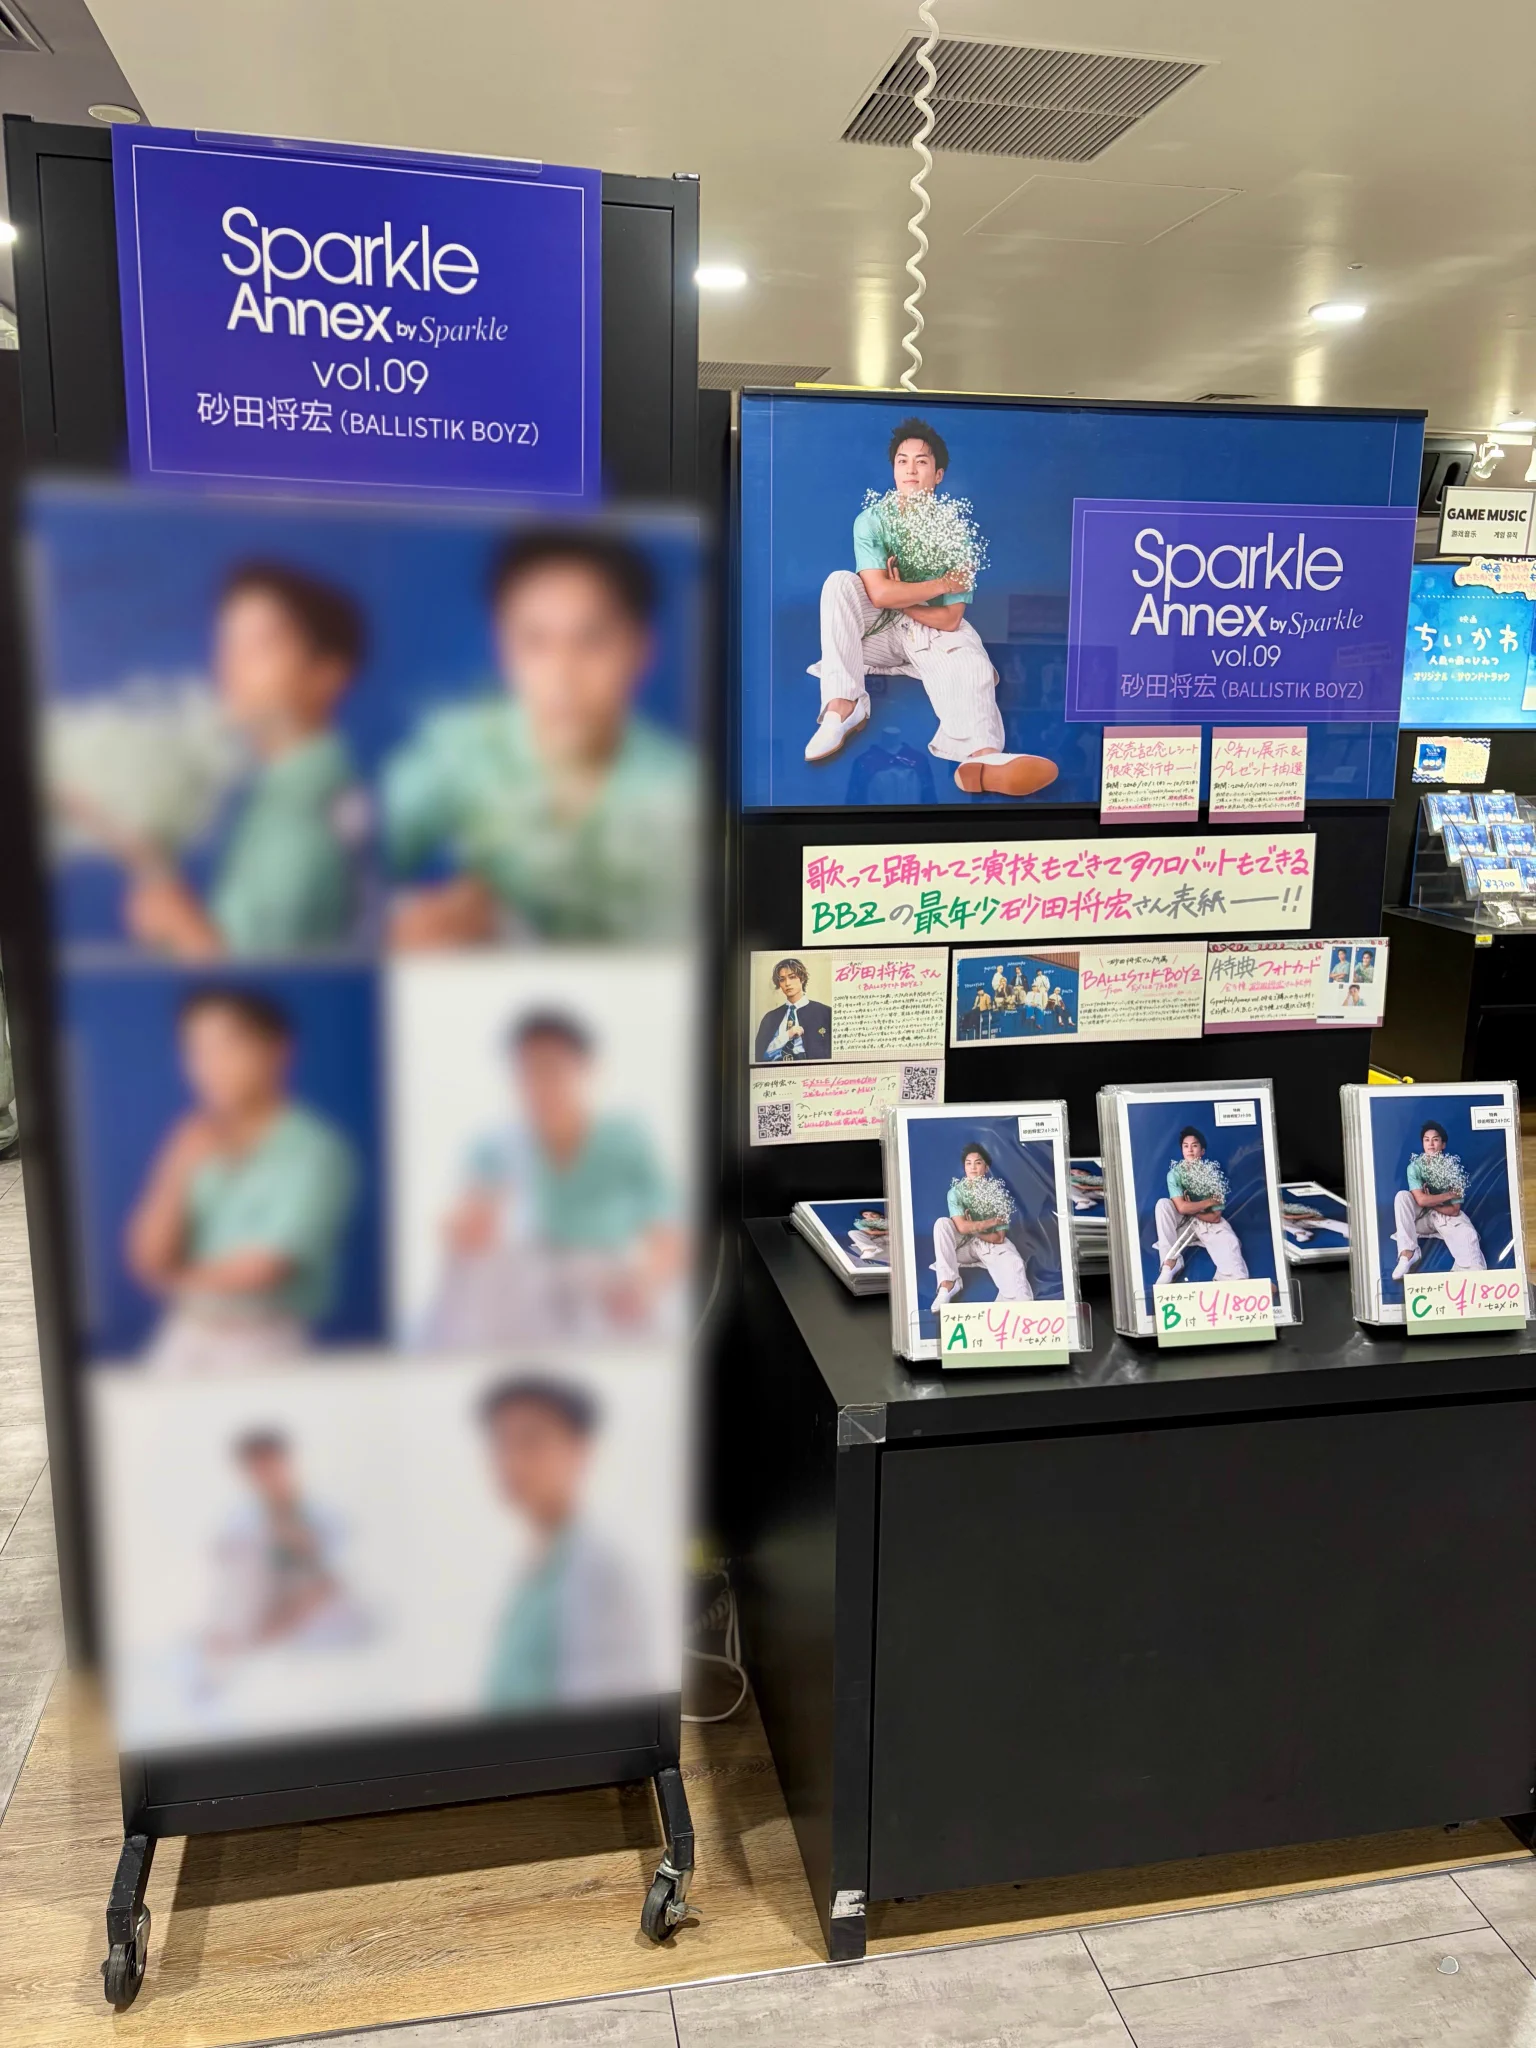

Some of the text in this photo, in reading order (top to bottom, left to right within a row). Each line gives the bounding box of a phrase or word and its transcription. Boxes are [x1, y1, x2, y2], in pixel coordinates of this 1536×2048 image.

[221, 206, 479, 294] Sparkle
[227, 283, 508, 348] Annex by Sparkle
[313, 357, 429, 394] vol.09
[197, 392, 333, 434] 砂田将宏
[472, 413, 540, 446] BOYZ)
[1447, 508, 1527, 522] GAME MUSIC
[1132, 528, 1344, 601] Sparkle
[1130, 593, 1364, 638] Annex by Sparkle
[1414, 622, 1519, 653] ちいかわ
[1212, 645, 1281, 667] vol.09
[1120, 673, 1217, 699] 砂田将宏
[1315, 681, 1364, 700] BOYZ)
[920, 968, 942, 978] さん
[1081, 963, 1203, 990] BALLISTIK BOYZ
[1209, 955, 1321, 981] 特典 フォトカード
[1157, 1290, 1196, 1303] フォトカード
[1407, 1283, 1444, 1294] フォトカード
[943, 1310, 985, 1322] フォトカード
[1161, 1303, 1181, 1330] B
[1260, 1312, 1268, 1320] in
[1412, 1295, 1432, 1318] C
[1509, 1301, 1518, 1309] in
[947, 1323, 968, 1350] A
[1051, 1334, 1061, 1343] in
